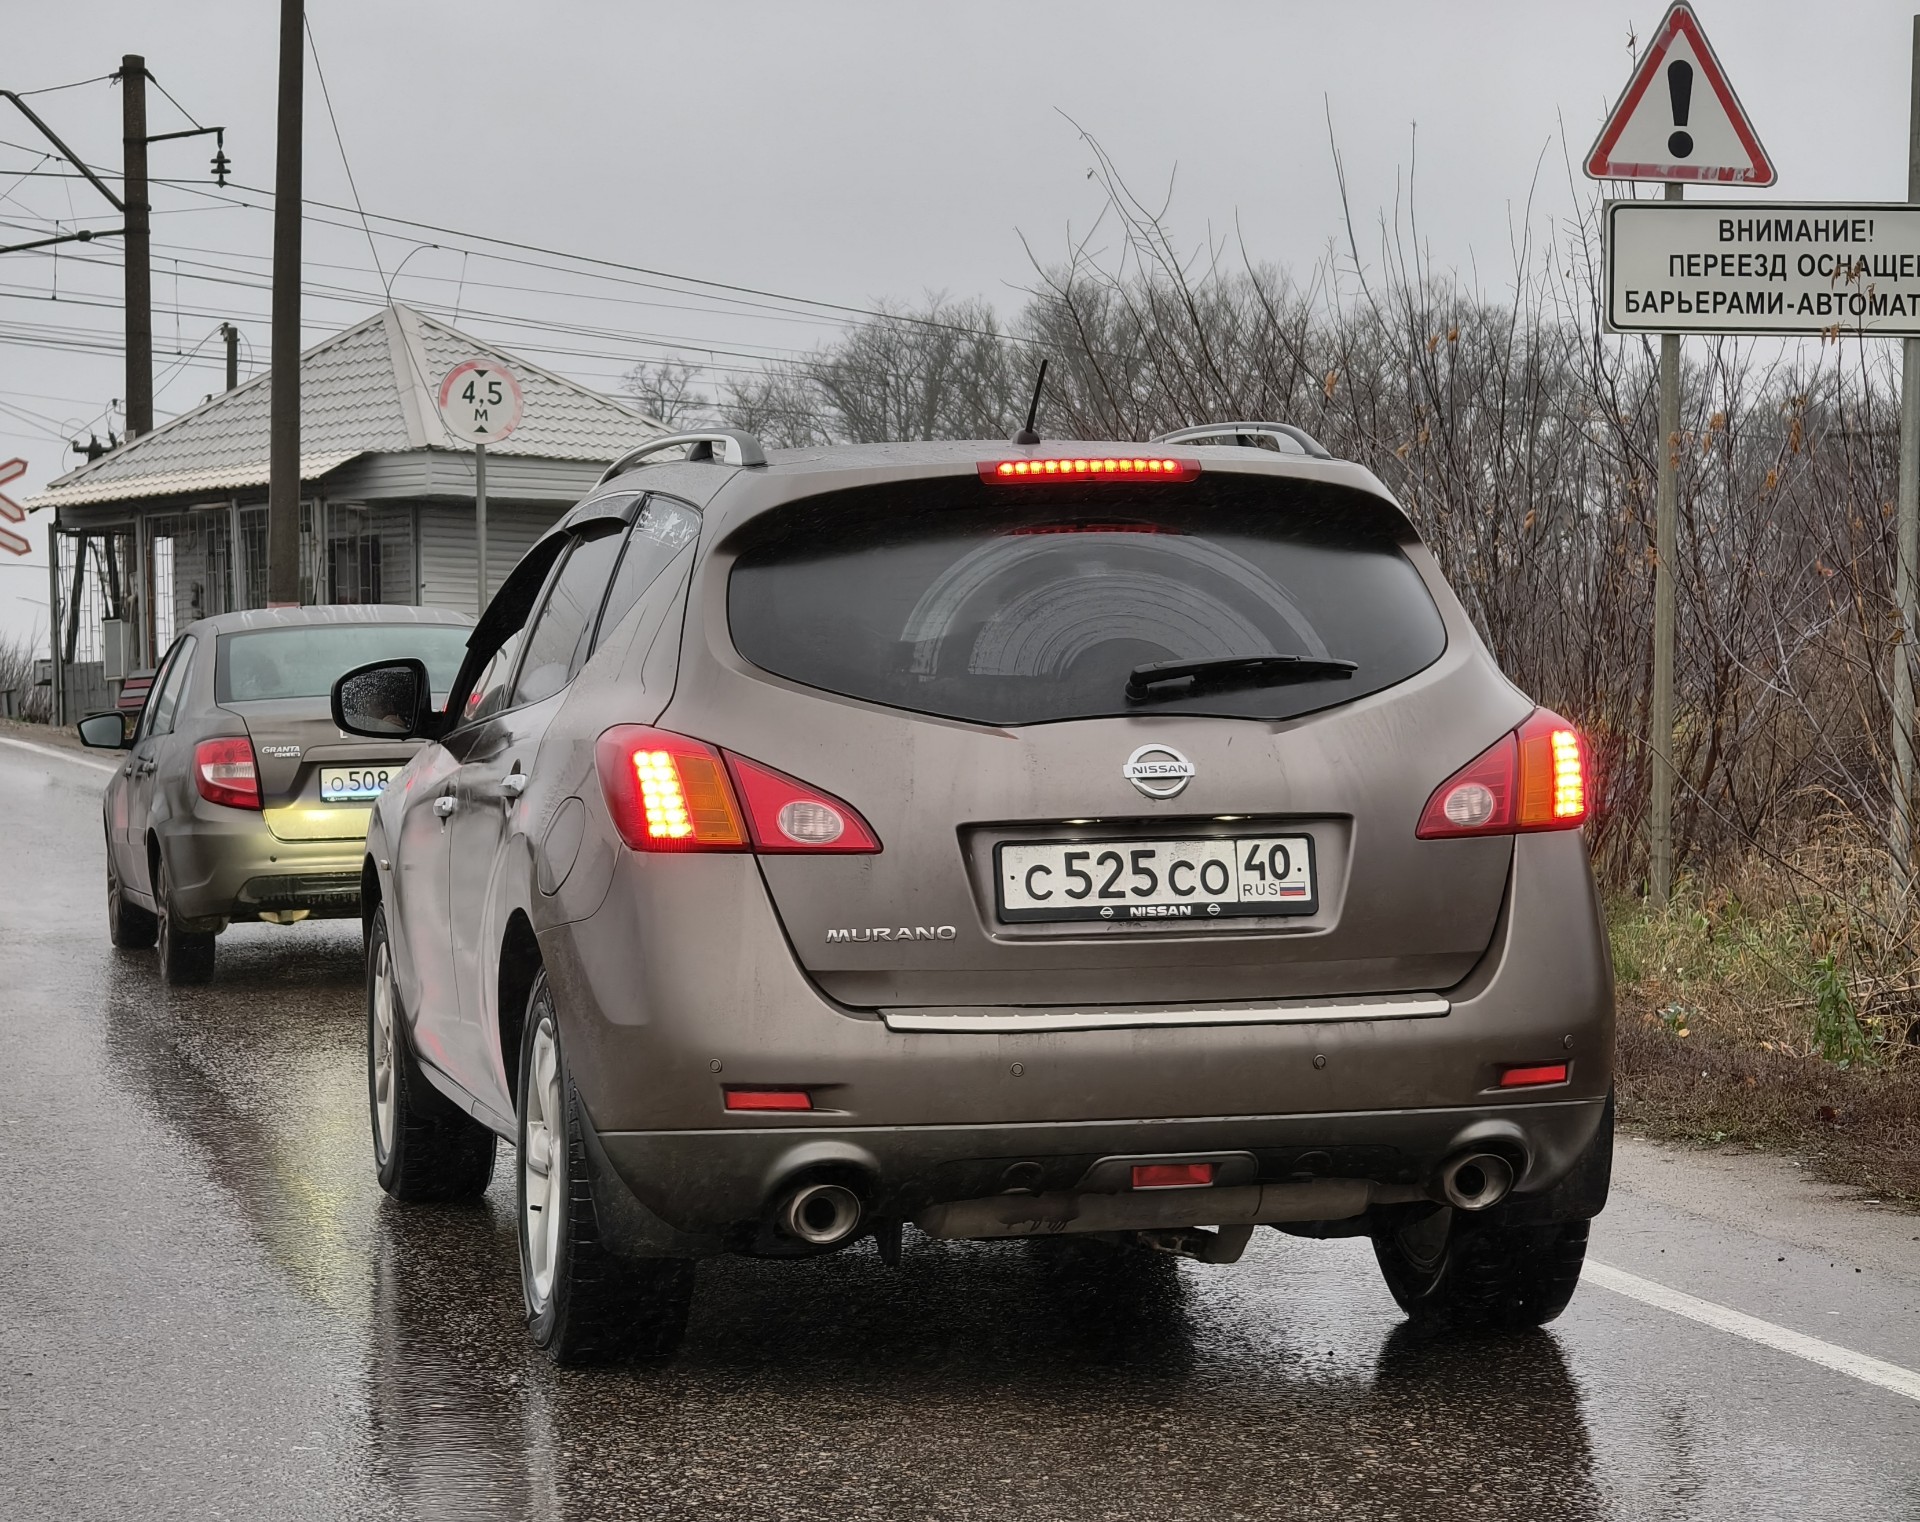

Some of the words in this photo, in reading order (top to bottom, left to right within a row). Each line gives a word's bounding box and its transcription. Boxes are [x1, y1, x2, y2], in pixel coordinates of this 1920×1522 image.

[1719, 218, 1874, 243] ВНИМАНИЕ!
[1669, 253, 1787, 282] ПЕРЕЕЗД
[1797, 253, 1920, 282] ОСНАЩЕ
[1625, 290, 1920, 317] БАРЬЕРАМИ-АВТОМАТ
[461, 380, 503, 407] 4,5
[261, 745, 300, 754] GRANTA
[1132, 764, 1189, 776] NISSAN
[1243, 843, 1291, 881] 40
[1242, 882, 1279, 897] RUS
[1129, 905, 1192, 917] NISSAN
[825, 925, 957, 943] MURANO
